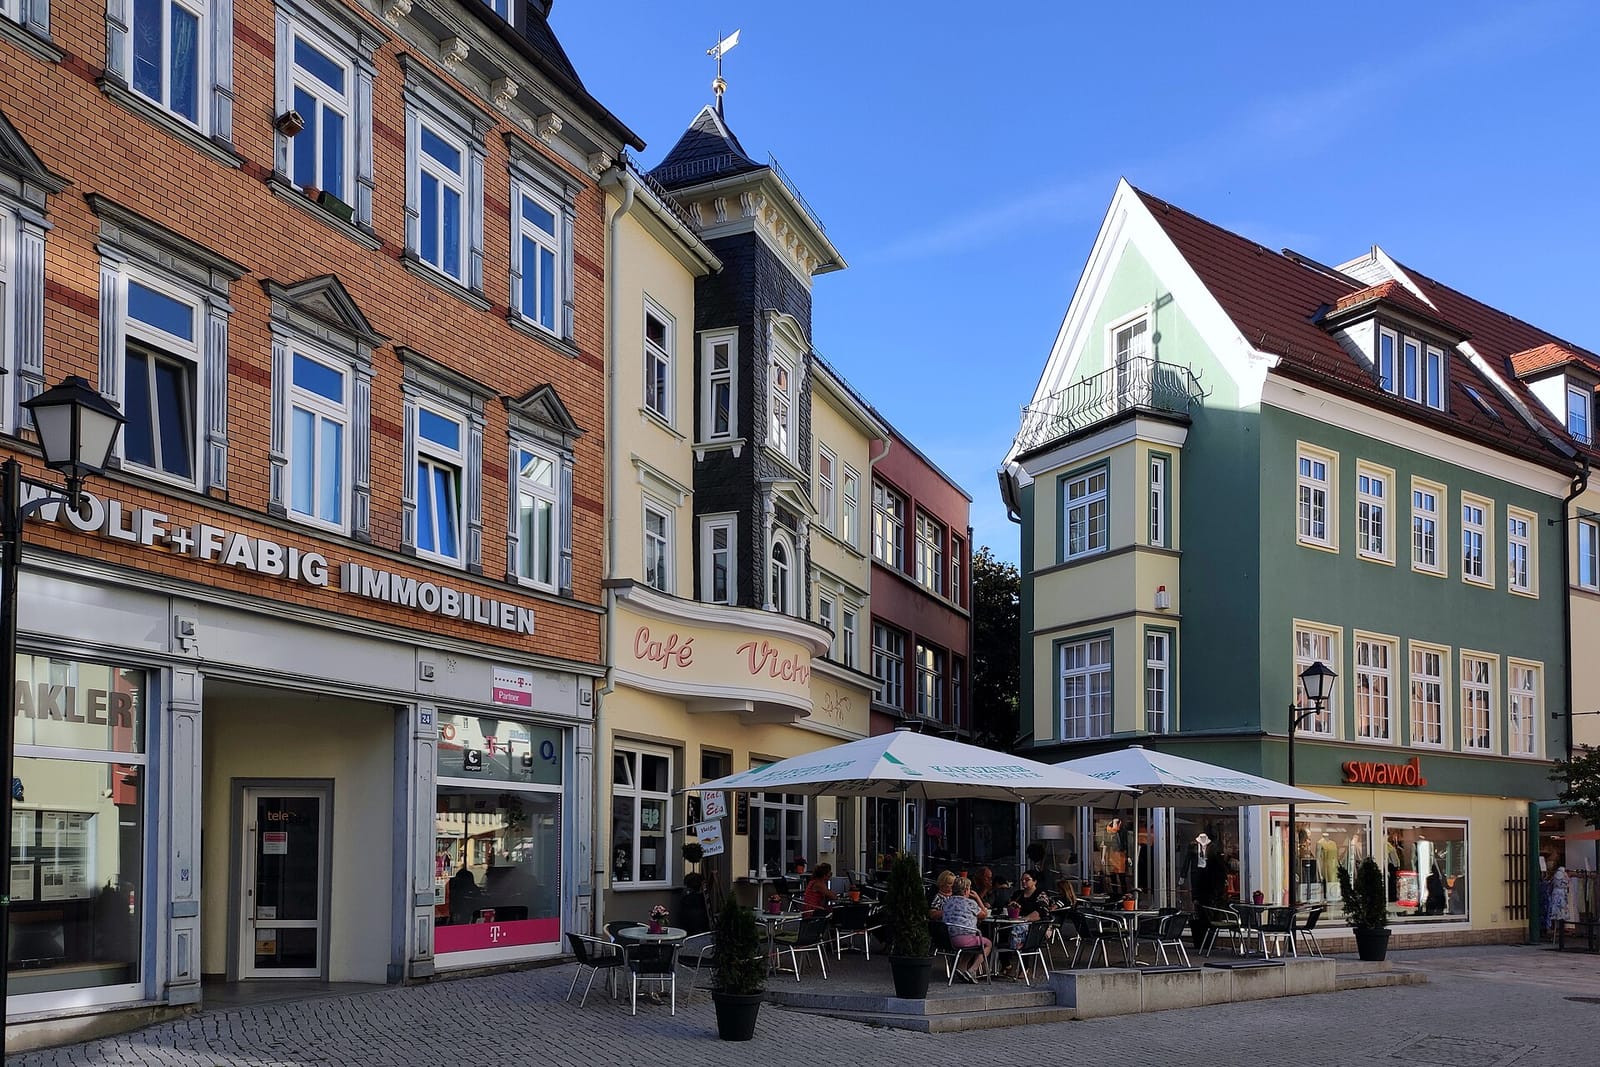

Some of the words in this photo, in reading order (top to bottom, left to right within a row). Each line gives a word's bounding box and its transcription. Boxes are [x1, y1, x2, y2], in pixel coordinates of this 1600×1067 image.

[341, 561, 535, 635] IMMOBILIEN
[633, 626, 694, 669] Café
[15, 680, 133, 729] AKLER
[498, 690, 520, 702] Partner
[422, 715, 431, 723] 24
[706, 802, 723, 816] Eis
